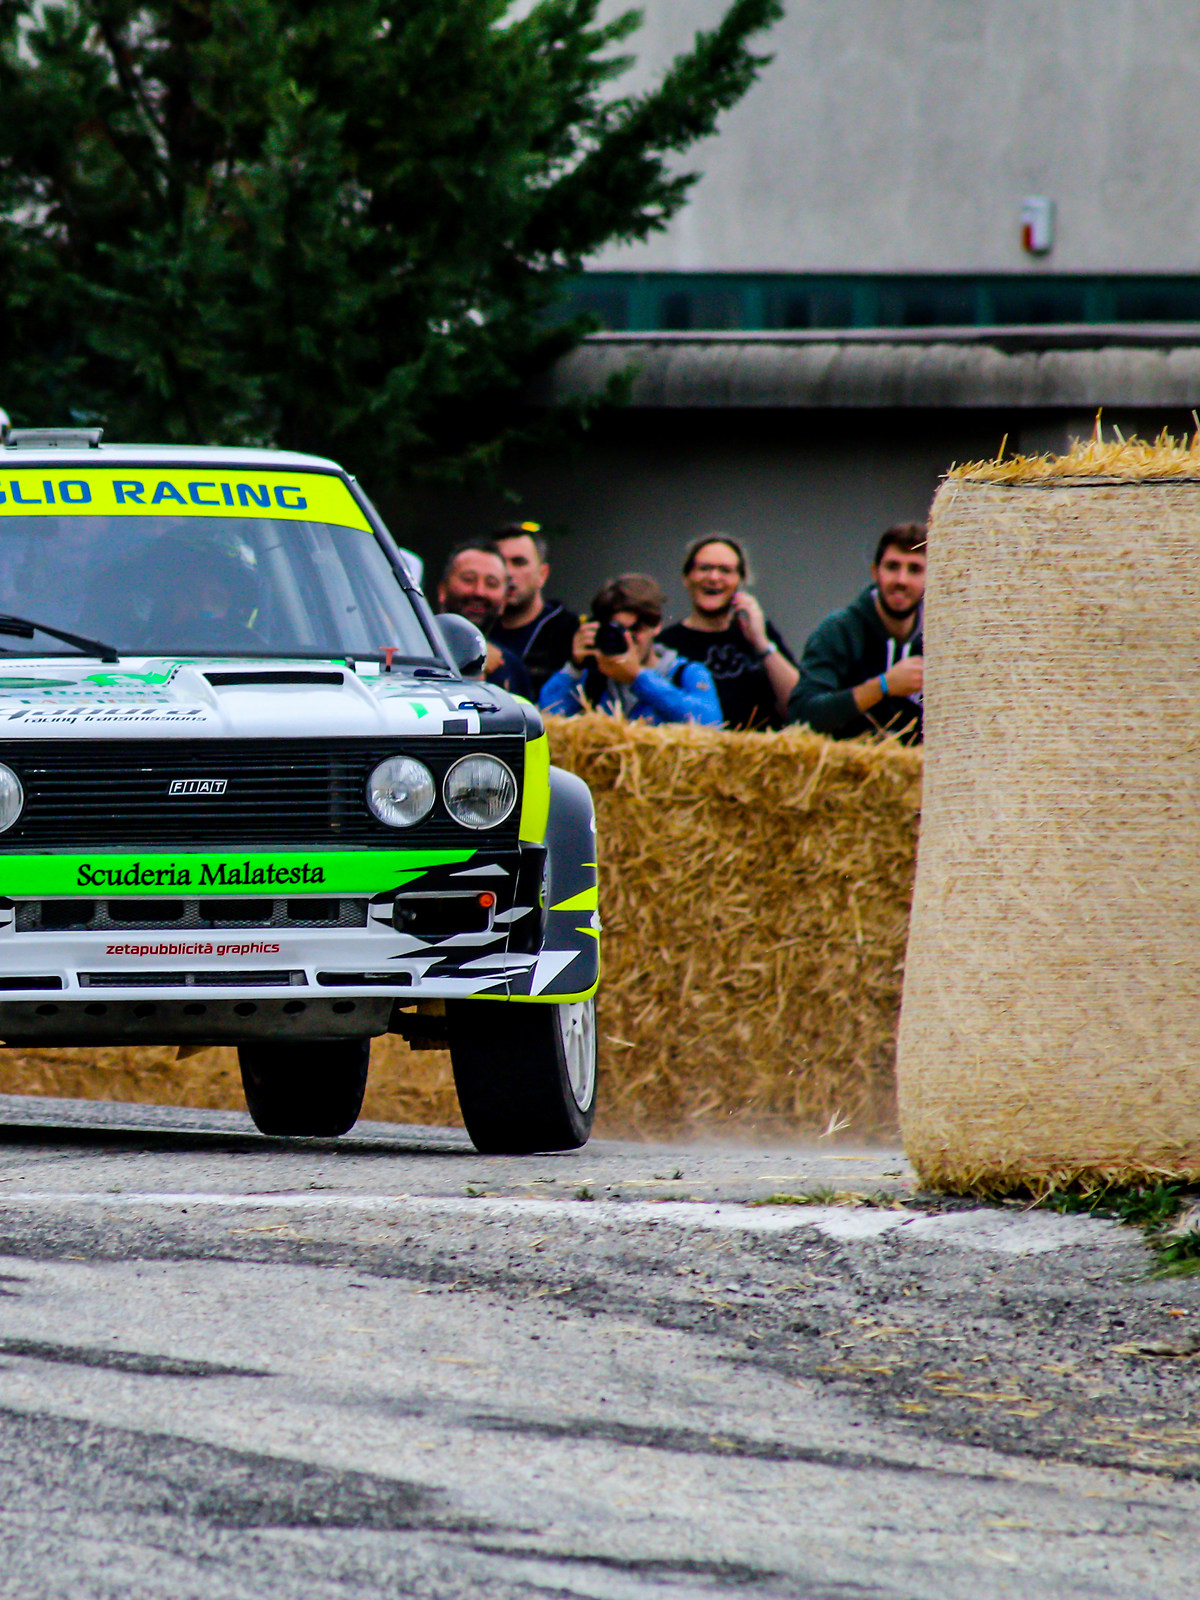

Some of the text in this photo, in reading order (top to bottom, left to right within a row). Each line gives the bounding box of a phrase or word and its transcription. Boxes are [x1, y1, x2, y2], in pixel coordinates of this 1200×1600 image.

[112, 480, 307, 510] RACING
[171, 781, 225, 793] FIAT
[77, 861, 326, 887] Scuderia Malatesta
[106, 942, 280, 956] zetapubblicità graphics
